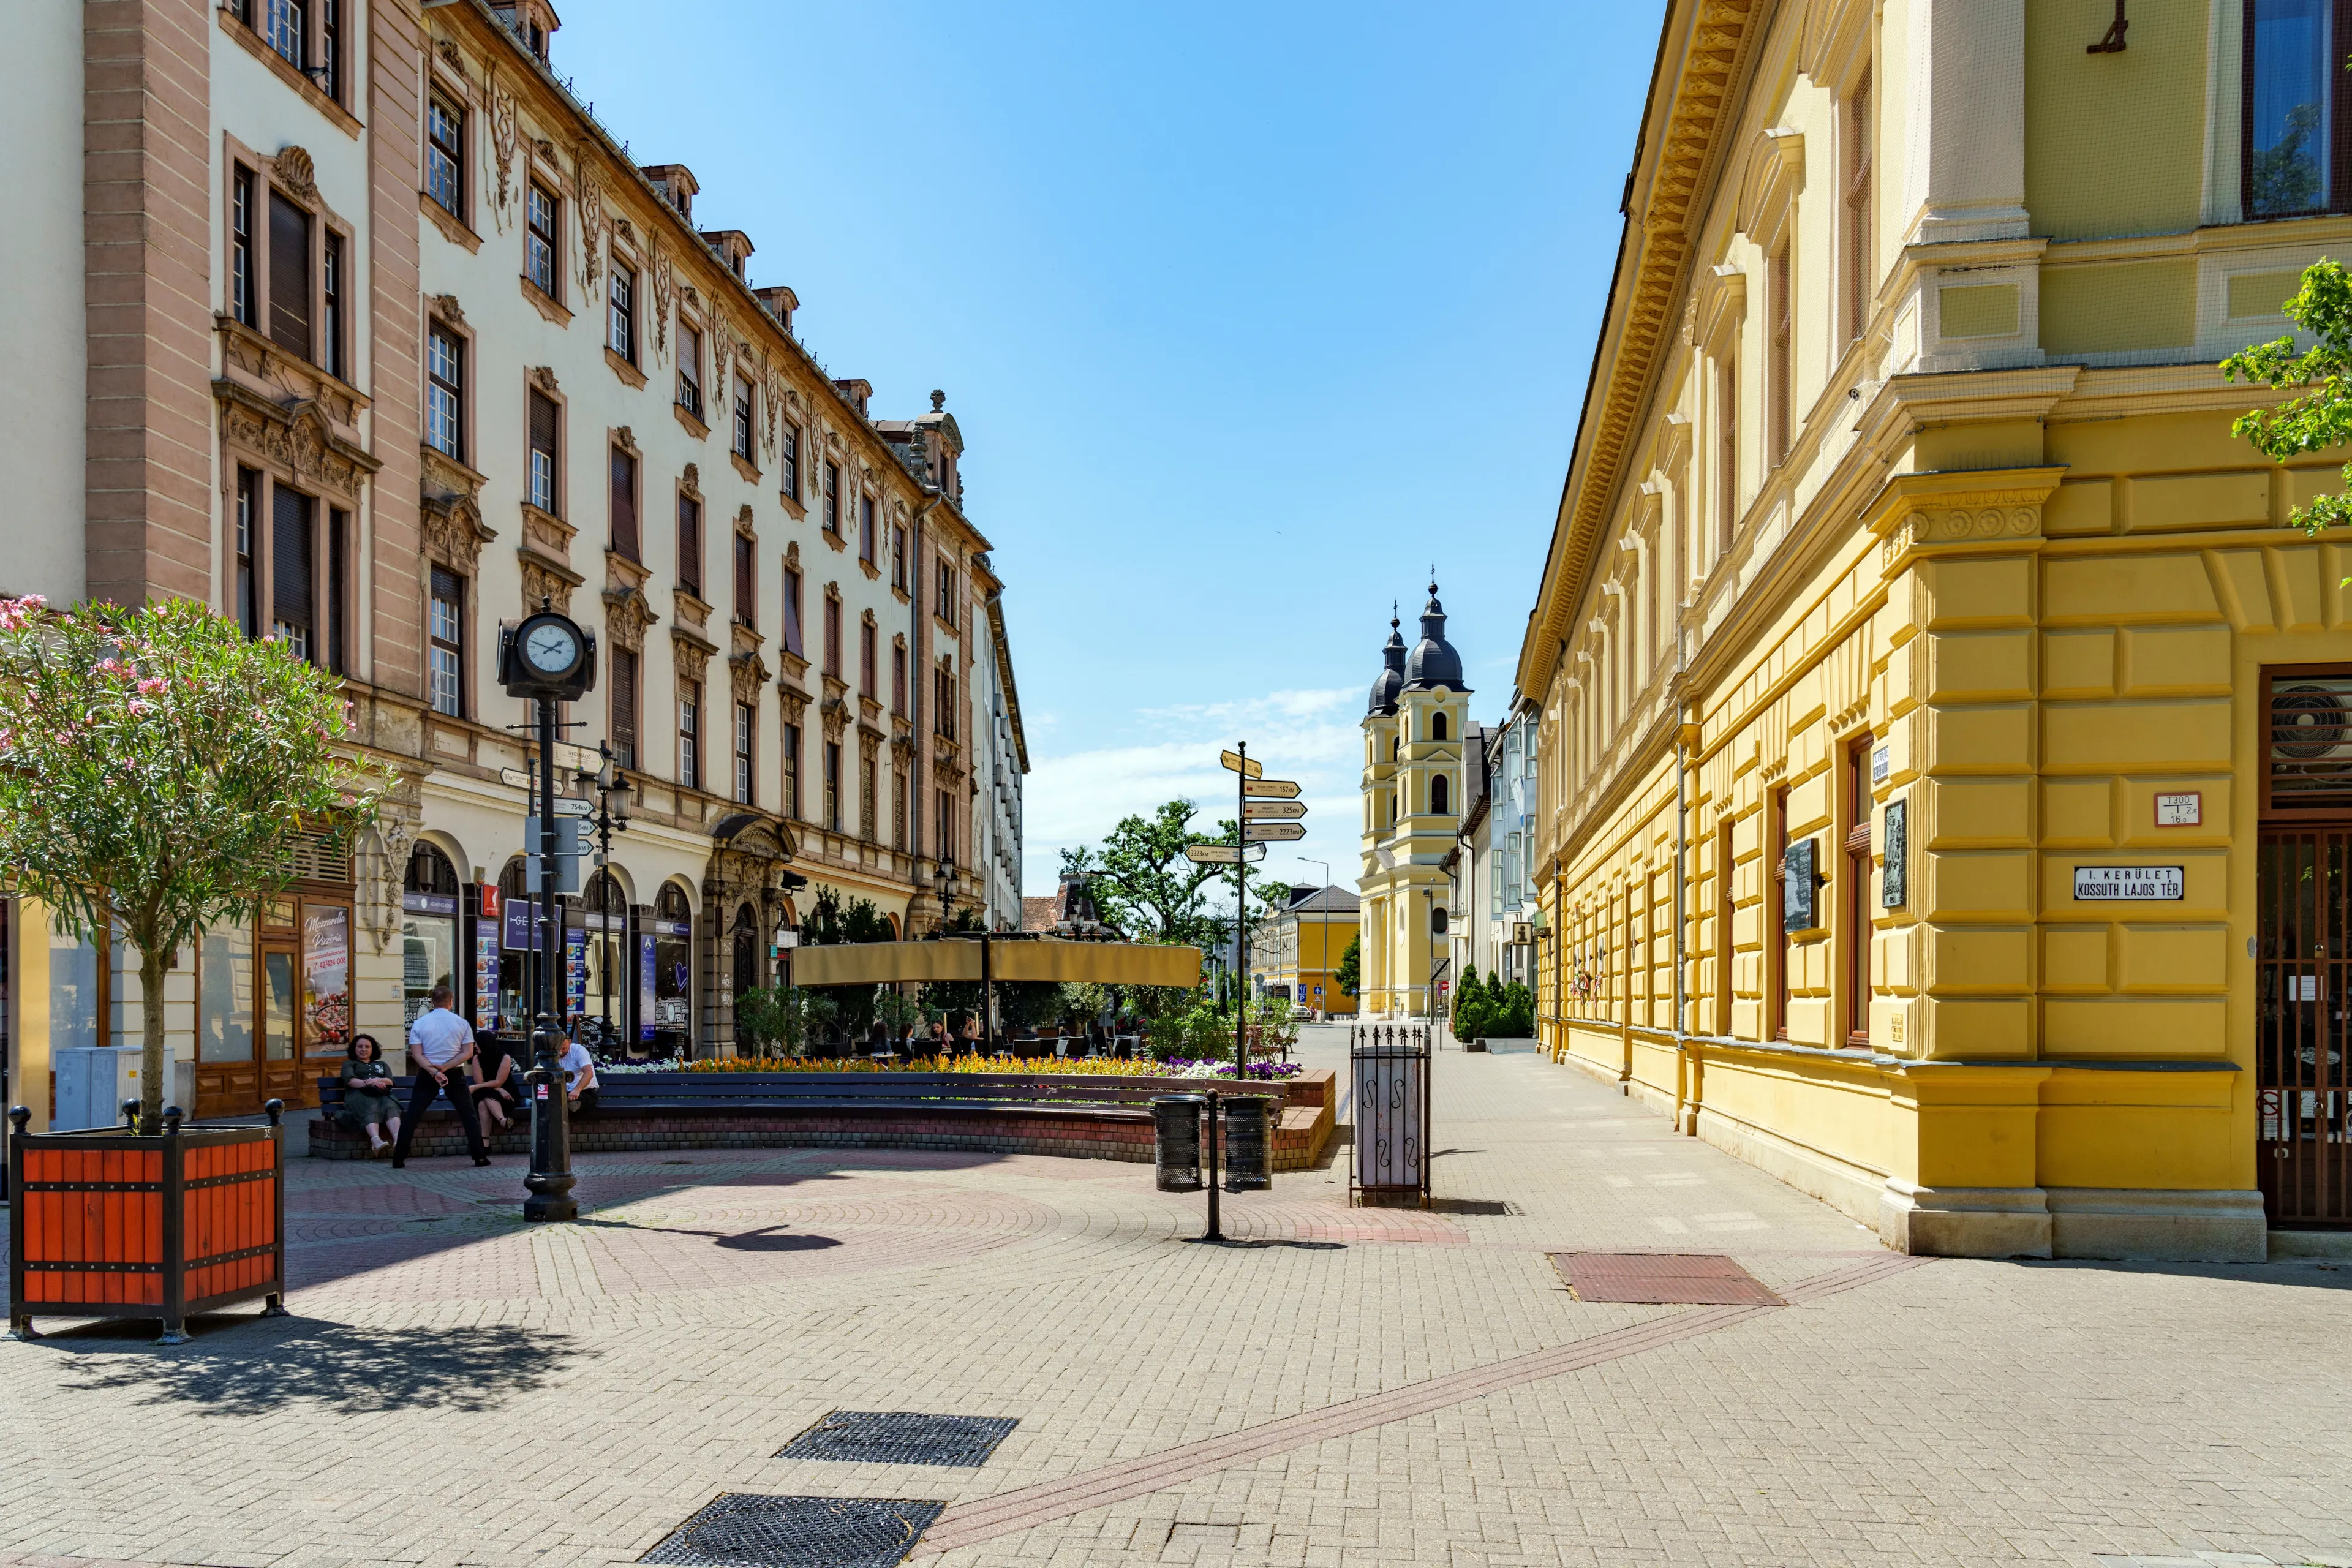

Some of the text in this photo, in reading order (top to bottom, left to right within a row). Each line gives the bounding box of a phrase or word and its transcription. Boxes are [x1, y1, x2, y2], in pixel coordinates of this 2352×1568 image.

[567, 750, 591, 760] INFORMÁCIÓ
[2166, 796, 2190, 804] T300
[2089, 869, 2171, 880] I. KERÜLET
[2078, 880, 2179, 896] KOSSUTH LAJOS TÉR
[304, 911, 345, 933] Mozzarella
[312, 932, 342, 951] Pizzéria
[319, 956, 346, 969] 42/424-008
